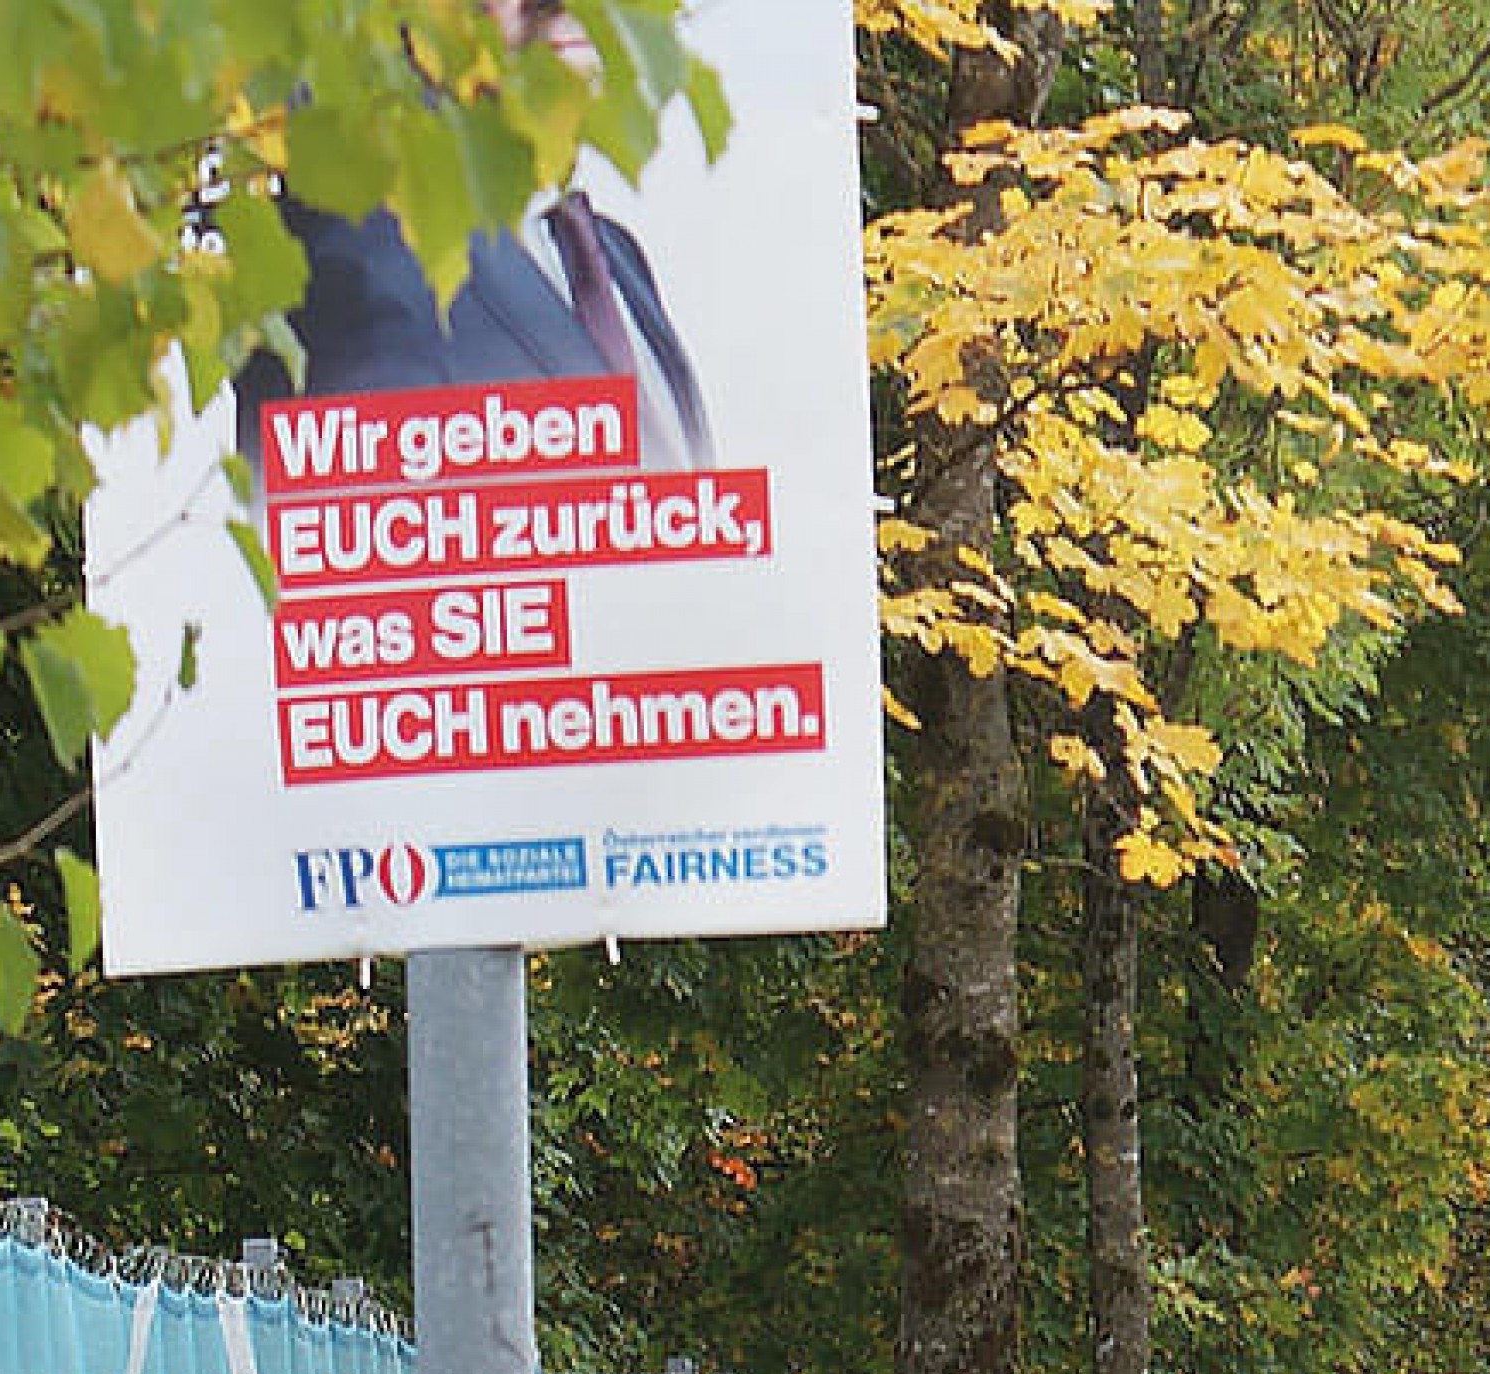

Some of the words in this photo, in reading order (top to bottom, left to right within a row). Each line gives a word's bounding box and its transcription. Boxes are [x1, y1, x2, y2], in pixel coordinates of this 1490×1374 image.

[273, 406, 389, 478] Wir
[398, 396, 622, 482] geben
[278, 493, 477, 575] EUCH
[493, 478, 763, 554] zurück,
[282, 613, 415, 671] was
[430, 587, 553, 658] SIE
[288, 690, 487, 768] EUCH
[503, 682, 820, 752] nehmen.
[604, 845, 828, 889] FAIRNESS
